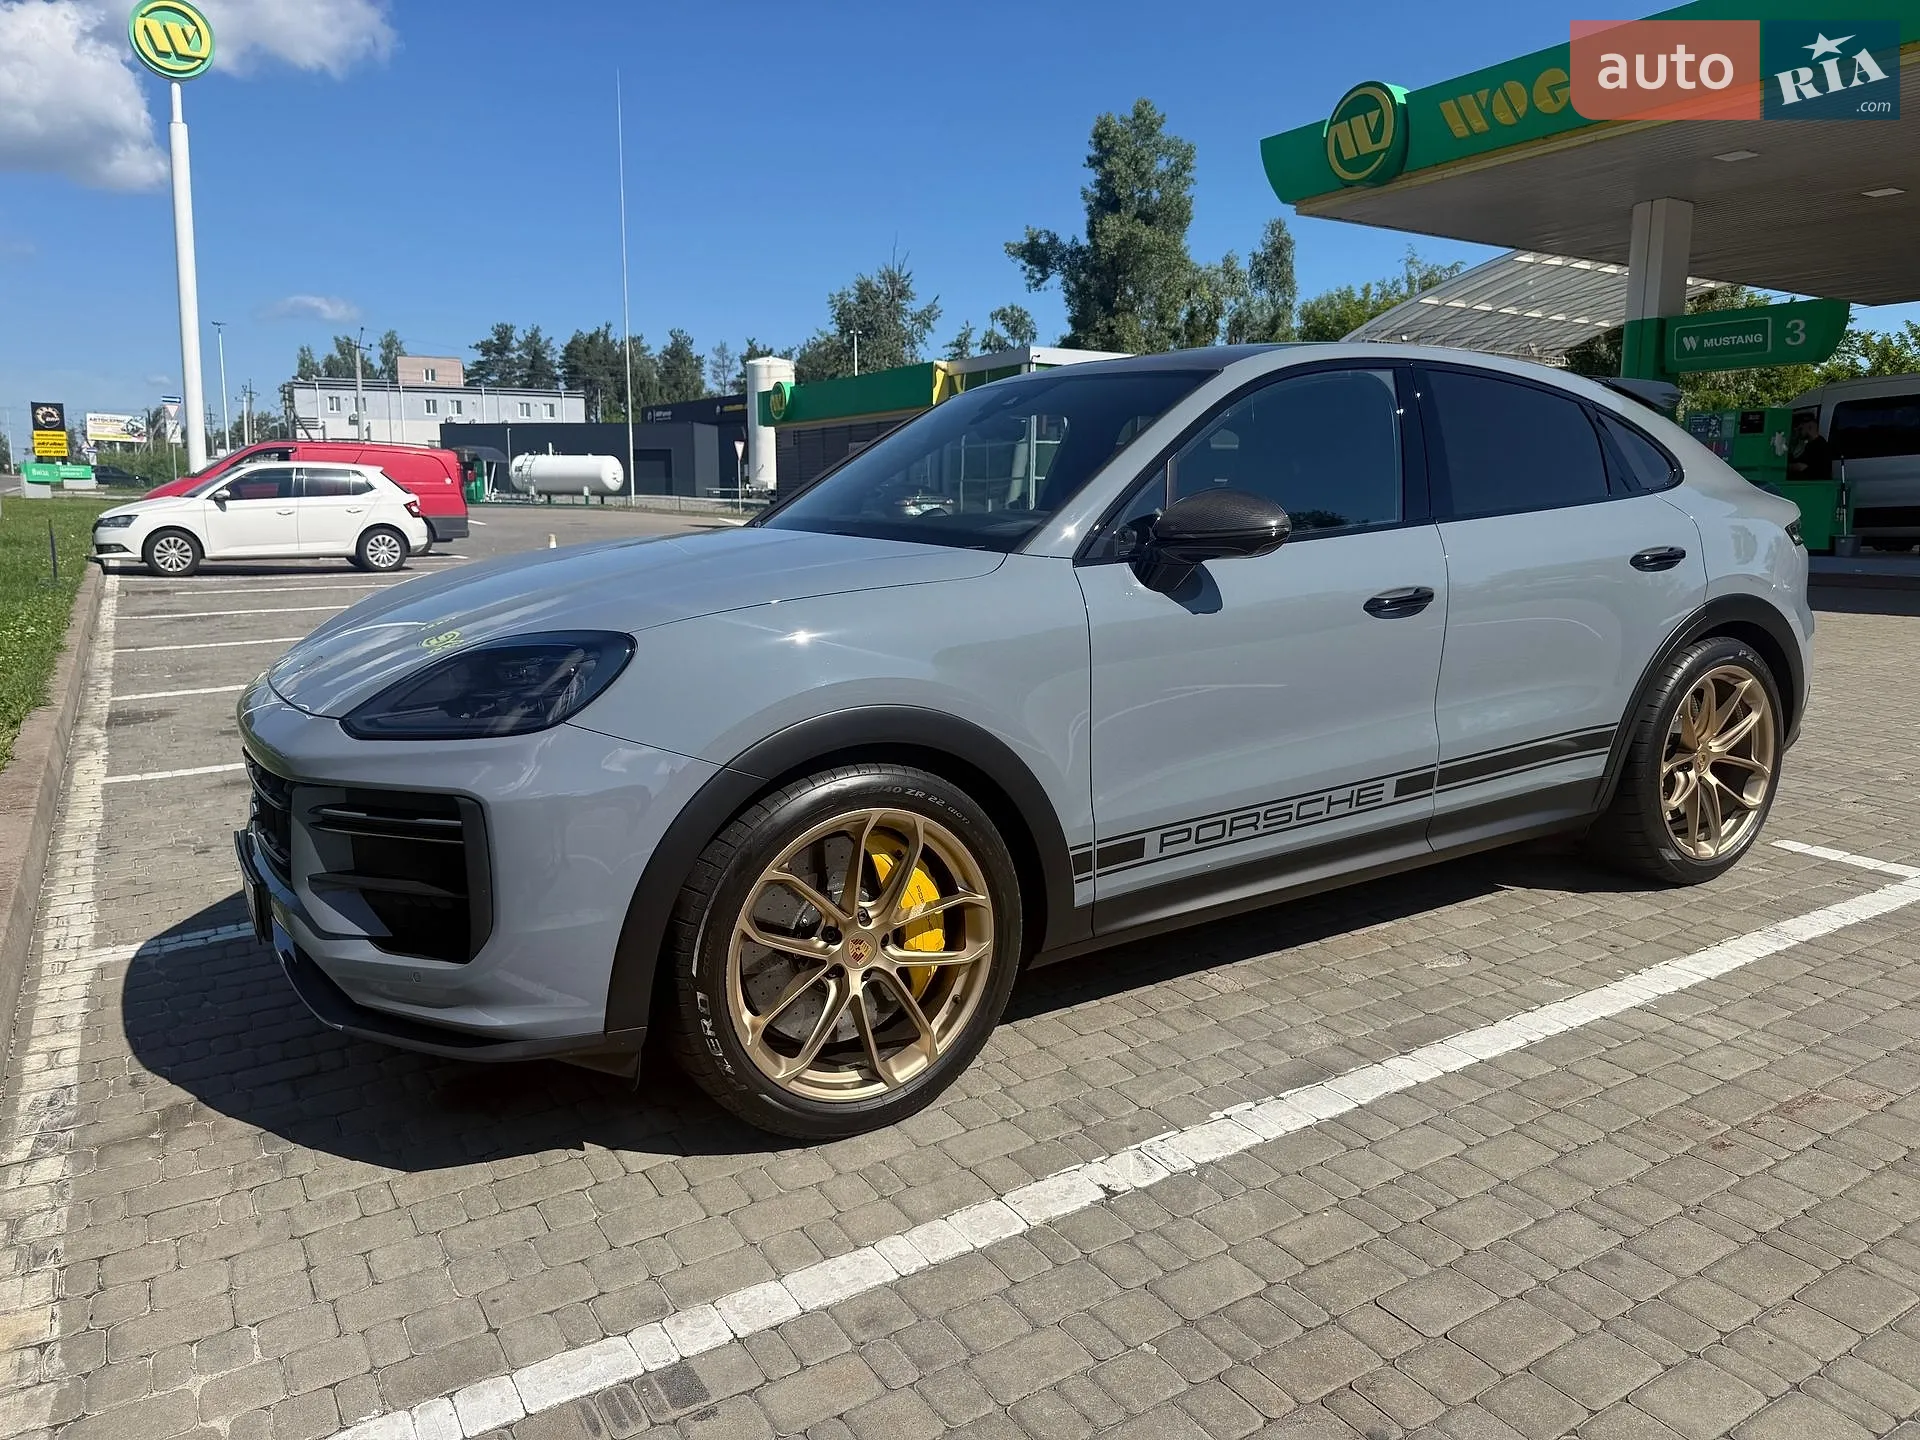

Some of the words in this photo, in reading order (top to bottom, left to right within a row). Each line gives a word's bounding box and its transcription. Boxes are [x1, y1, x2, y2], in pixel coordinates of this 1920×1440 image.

[1439, 68, 1571, 139] WOG
[1703, 333, 1763, 348] MUSTANG
[1785, 319, 1806, 346] 3
[927, 794, 946, 807] 22
[1159, 783, 1385, 854] PORSCHE
